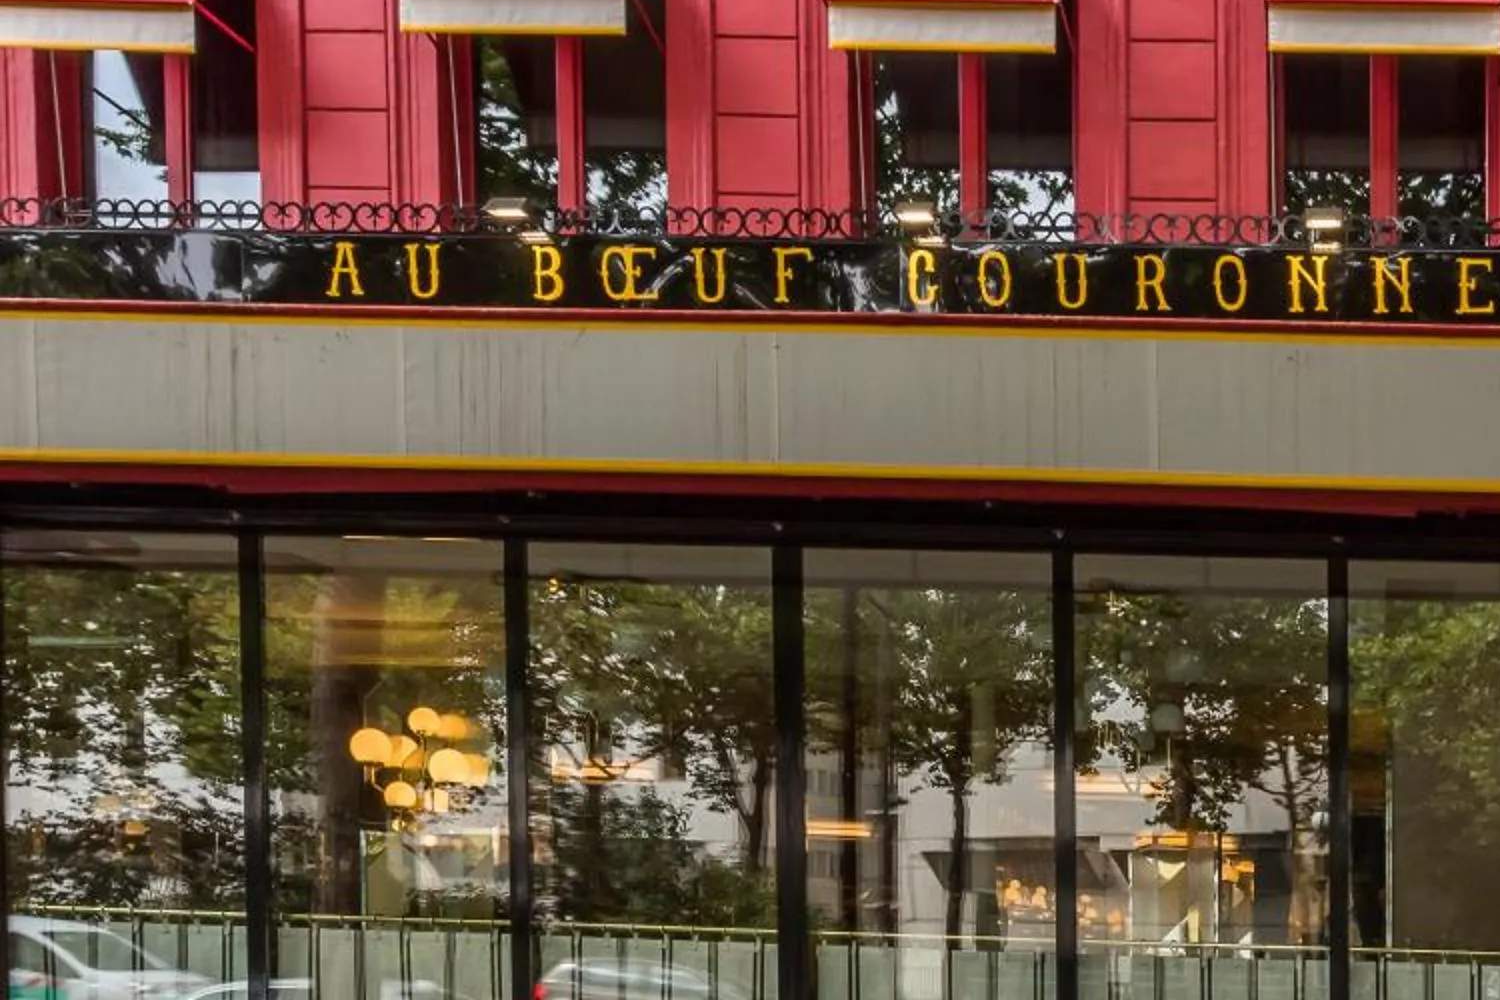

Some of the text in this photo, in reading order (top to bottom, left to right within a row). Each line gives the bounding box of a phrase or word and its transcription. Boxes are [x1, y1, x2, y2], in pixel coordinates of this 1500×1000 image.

[326, 241, 1495, 314] AU BŒUF COURONNE
